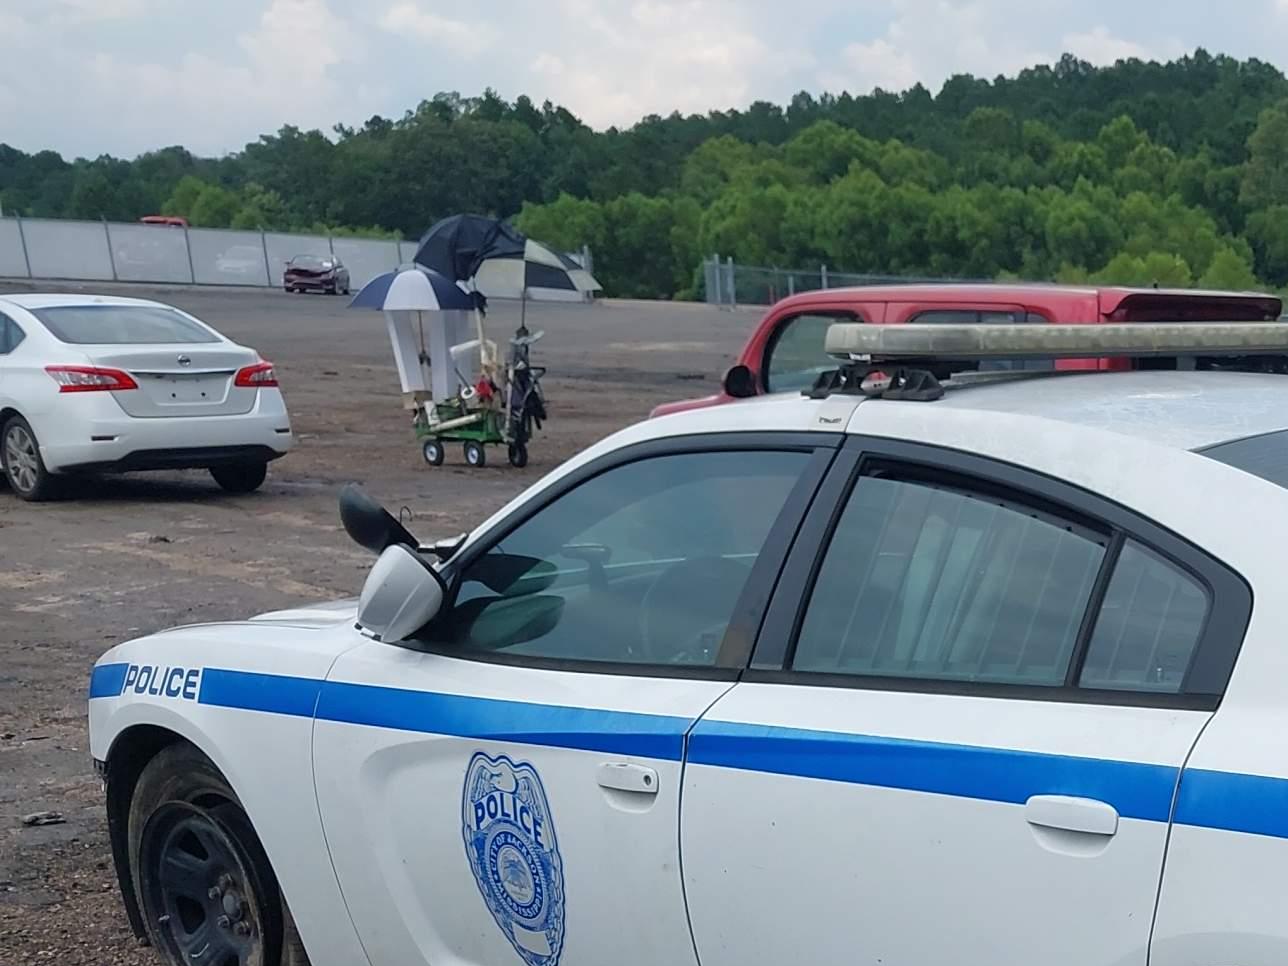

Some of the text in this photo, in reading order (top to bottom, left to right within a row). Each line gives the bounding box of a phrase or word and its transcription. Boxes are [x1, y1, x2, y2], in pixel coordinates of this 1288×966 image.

[123, 664, 200, 700] POLICE
[474, 791, 546, 850] POLICE
[490, 838, 502, 872] CITY
[507, 832, 543, 885] JACKSON
[496, 881, 544, 919] MISSISSIPPI
